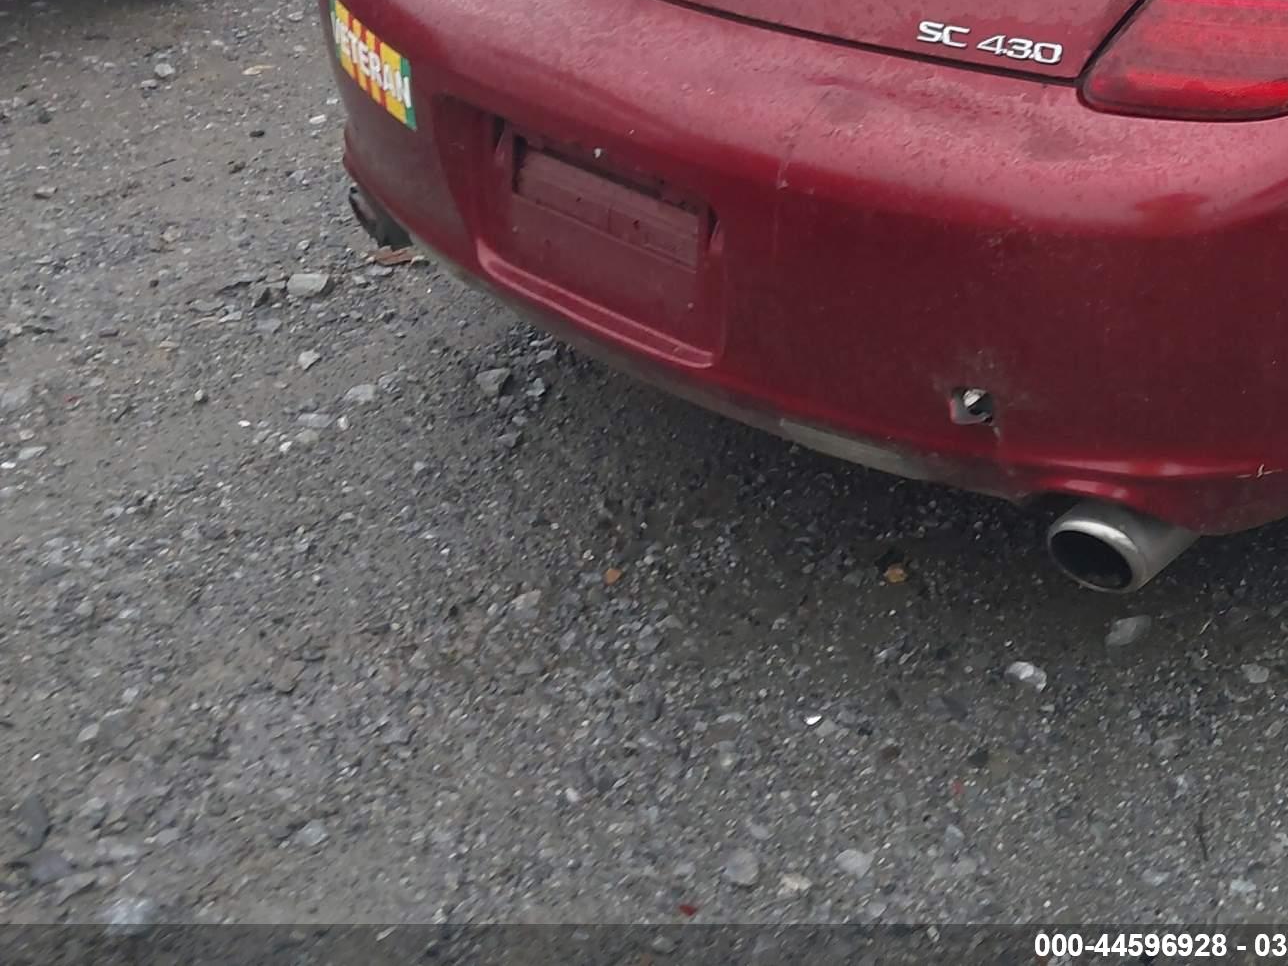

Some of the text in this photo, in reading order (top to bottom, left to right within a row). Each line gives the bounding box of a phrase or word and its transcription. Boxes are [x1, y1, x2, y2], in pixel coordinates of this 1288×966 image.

[329, 10, 412, 109] VETERAN
[916, 20, 1063, 64] SC 430
